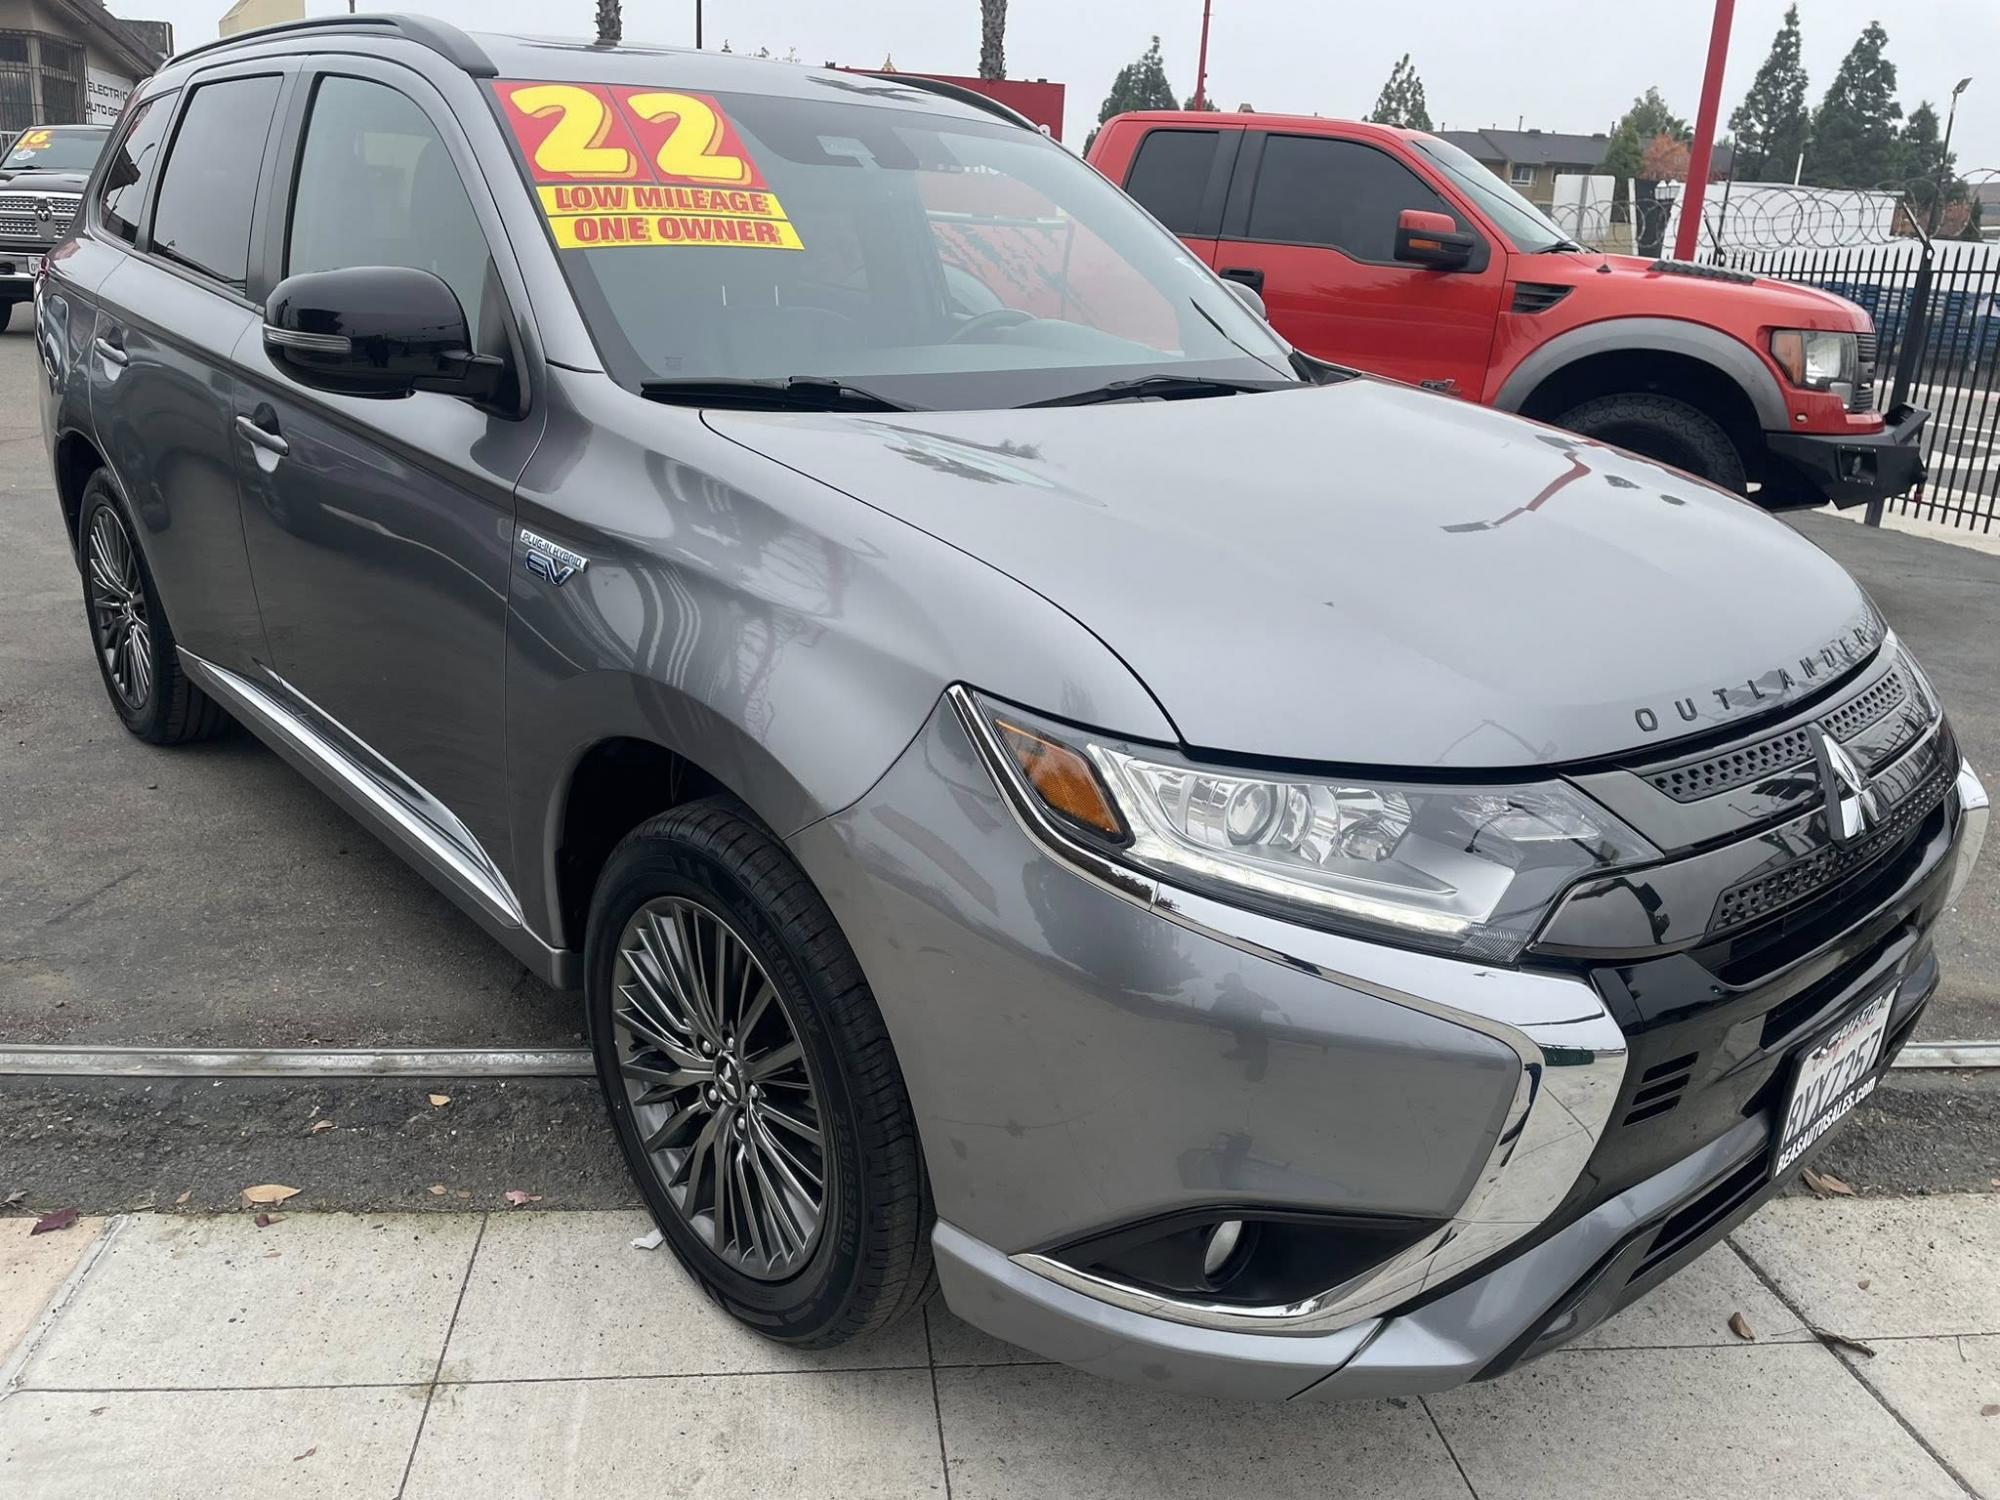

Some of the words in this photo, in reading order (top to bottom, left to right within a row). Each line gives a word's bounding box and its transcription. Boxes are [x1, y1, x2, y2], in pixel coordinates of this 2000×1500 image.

[86, 101, 107, 115] AUTO
[510, 85, 751, 185] 22
[555, 186, 628, 211] LOW
[634, 187, 773, 216] MILEAGE
[574, 216, 650, 243] ONE
[657, 217, 782, 246] OWNER
[1634, 626, 1869, 733] OUTLANDER
